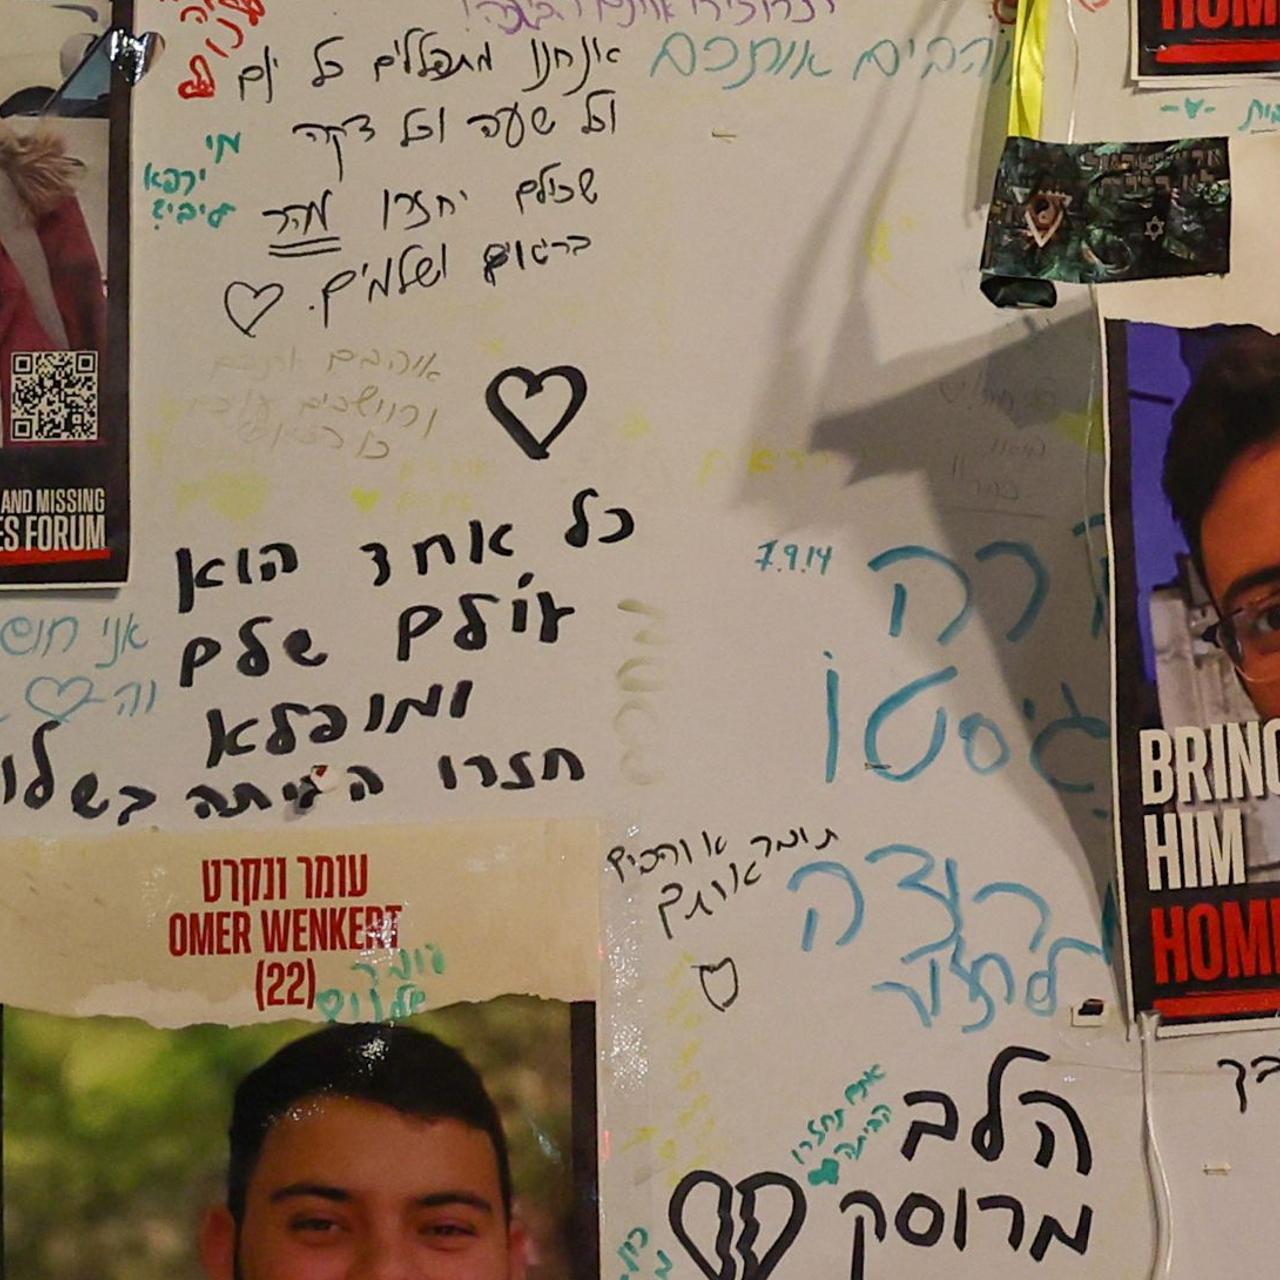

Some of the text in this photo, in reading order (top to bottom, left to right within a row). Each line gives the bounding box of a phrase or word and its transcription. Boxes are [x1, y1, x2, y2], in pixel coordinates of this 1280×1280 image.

[1, 490, 32, 513] AND
[37, 489, 104, 513] MISSING
[26, 515, 104, 550] FORUM
[1145, 808, 1245, 890] HIM
[202, 854, 369, 904] עומר ונקרט
[169, 904, 403, 957] OMER WENKERT
[255, 960, 317, 1009] (22)
